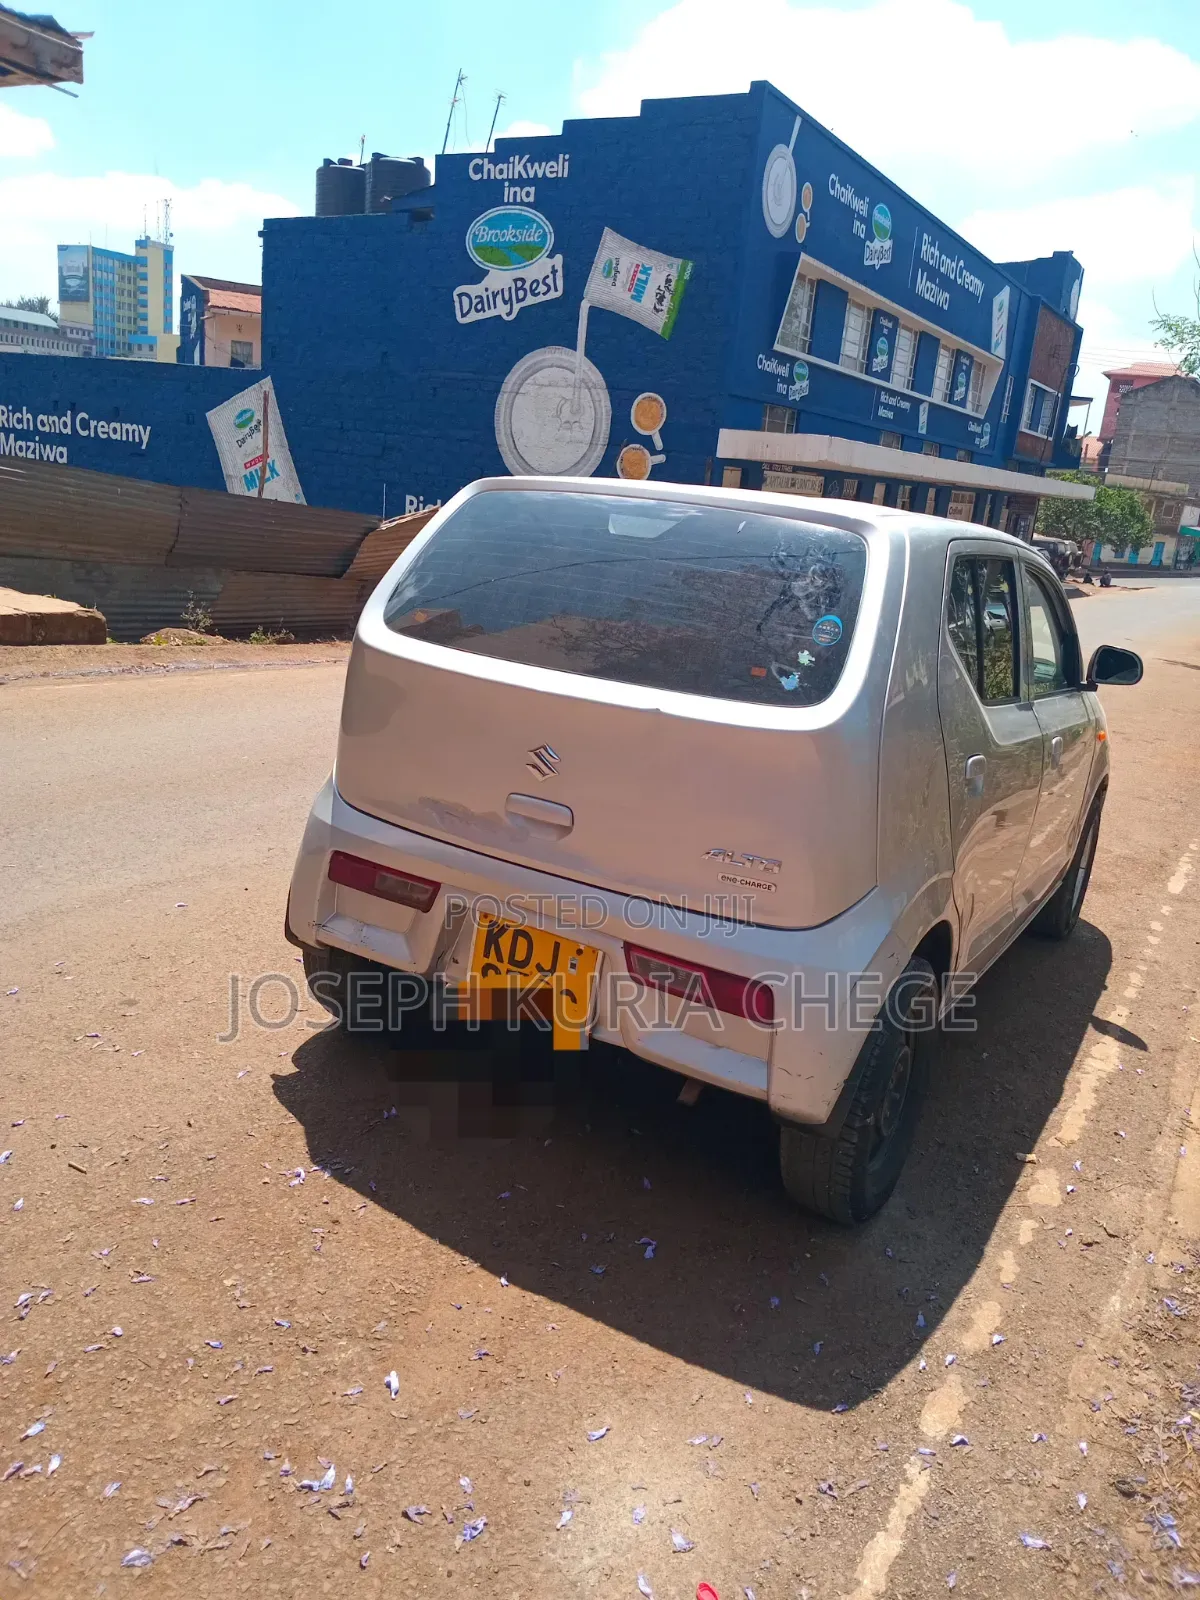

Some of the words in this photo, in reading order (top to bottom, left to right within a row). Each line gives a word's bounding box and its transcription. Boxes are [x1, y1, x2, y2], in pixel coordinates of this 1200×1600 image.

[469, 154, 570, 180] ChaiKweli
[503, 181, 536, 203] ina
[828, 173, 870, 218] ChaiKweli
[475, 223, 544, 243] Brookside
[852, 212, 867, 240] ina
[630, 262, 654, 304] MILK
[920, 232, 940, 270] Rich
[939, 253, 958, 280] and
[956, 259, 985, 304] Creamy
[456, 264, 559, 319] DairyBest
[915, 267, 950, 311] Maziwa
[776, 378, 788, 395] ina
[0, 404, 34, 431] Rich
[36, 410, 72, 435] and
[75, 412, 151, 450] Creamy
[0, 432, 68, 464] Maziwa
[405, 494, 441, 515] Ri
[482, 919, 562, 979] KDJ
